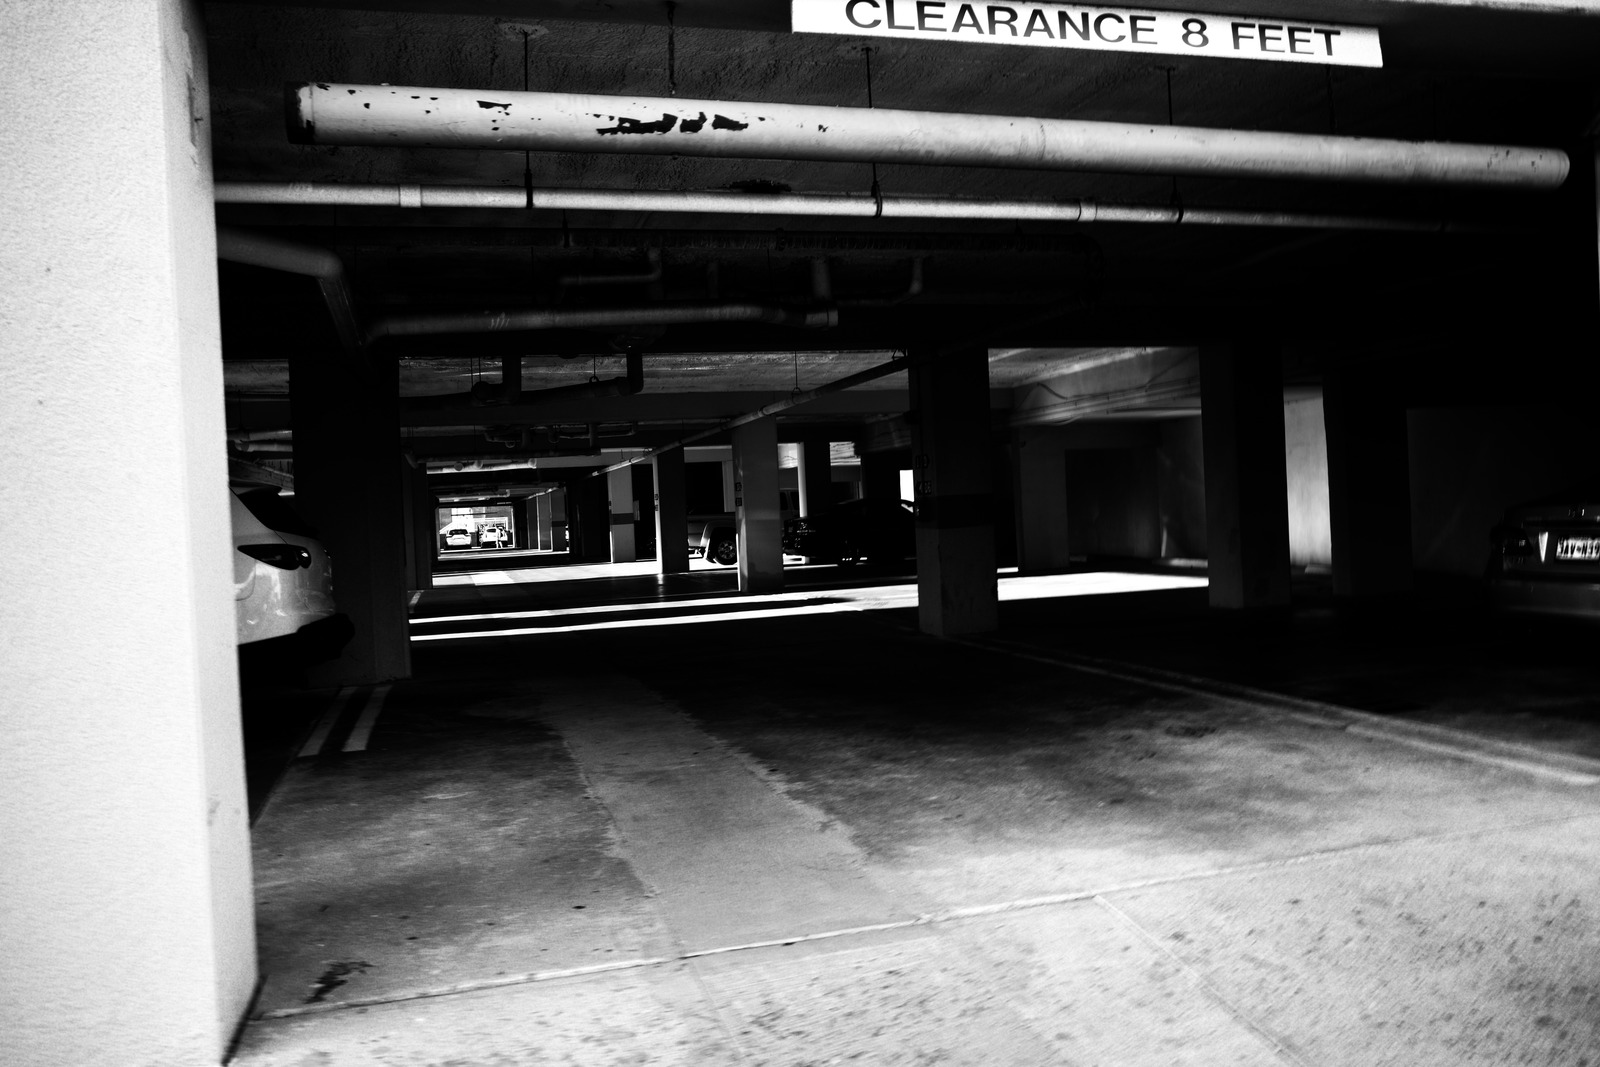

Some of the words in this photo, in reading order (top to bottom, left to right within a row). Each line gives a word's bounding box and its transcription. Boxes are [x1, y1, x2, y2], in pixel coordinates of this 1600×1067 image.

[846, 0, 1157, 45] CLEARANCE
[1181, 18, 1209, 48] 8
[1231, 22, 1341, 57] FEET
